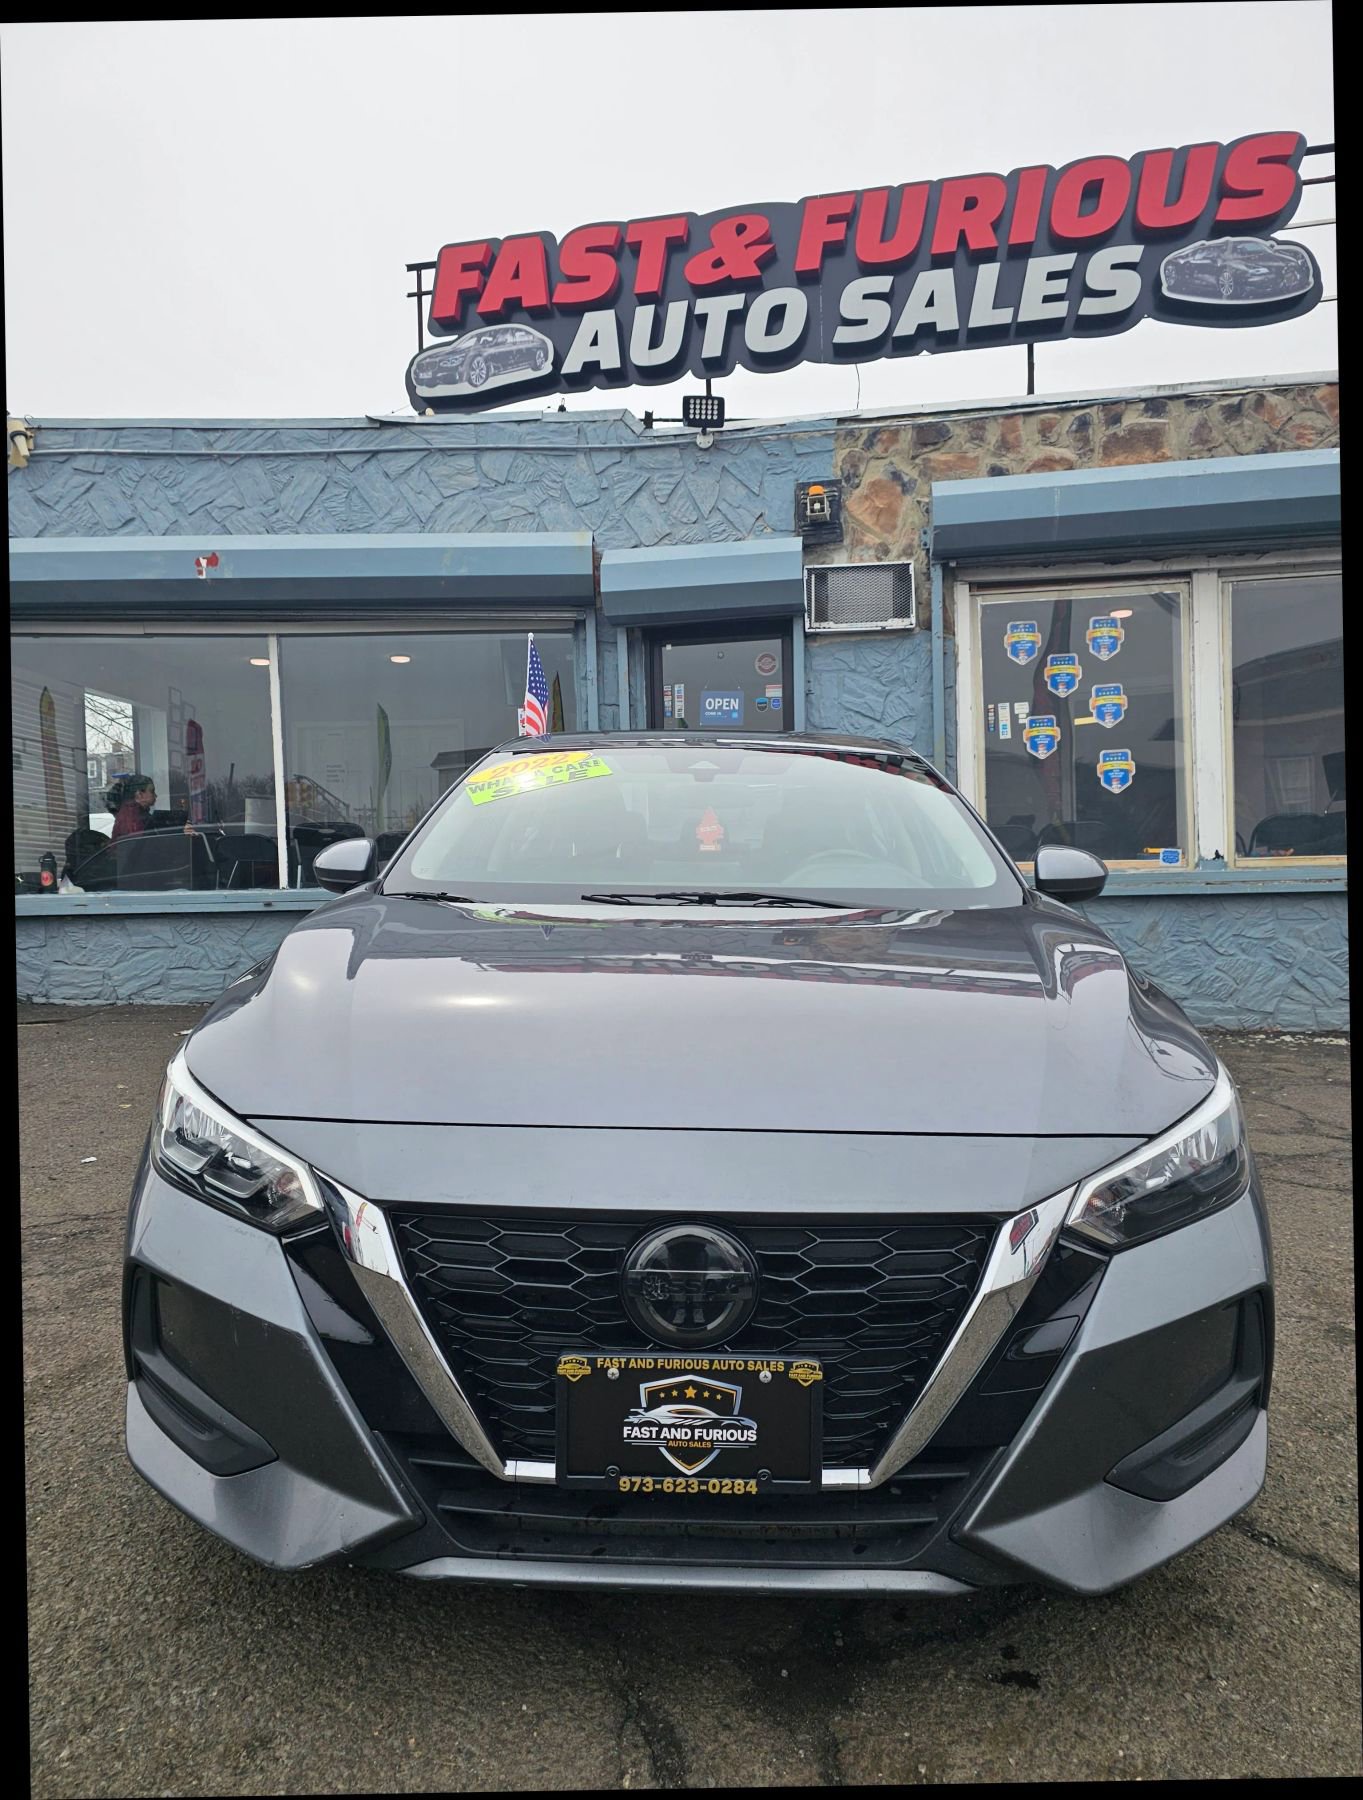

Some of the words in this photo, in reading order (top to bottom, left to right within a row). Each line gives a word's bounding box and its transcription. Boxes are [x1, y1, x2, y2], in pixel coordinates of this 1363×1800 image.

[432, 217, 690, 322] FAST
[684, 214, 776, 287] &
[794, 131, 1301, 274] FURIOUS
[560, 287, 808, 374] AUTO
[832, 245, 1145, 345] SALES
[705, 698, 739, 710] OPEN
[488, 753, 570, 779] 2022
[491, 769, 588, 797] SLE
[596, 1357, 627, 1369] FAST
[628, 1358, 655, 1369] AND
[657, 1358, 710, 1370] FURIOUS
[711, 1360, 745, 1371] AUTO
[747, 1360, 785, 1372] SALES
[623, 1426, 659, 1439] FAST
[660, 1427, 693, 1440] AND
[694, 1428, 757, 1442] FURIOUS
[668, 1440, 688, 1448] AUTO
[619, 1475, 758, 1494] 973-623-0284
